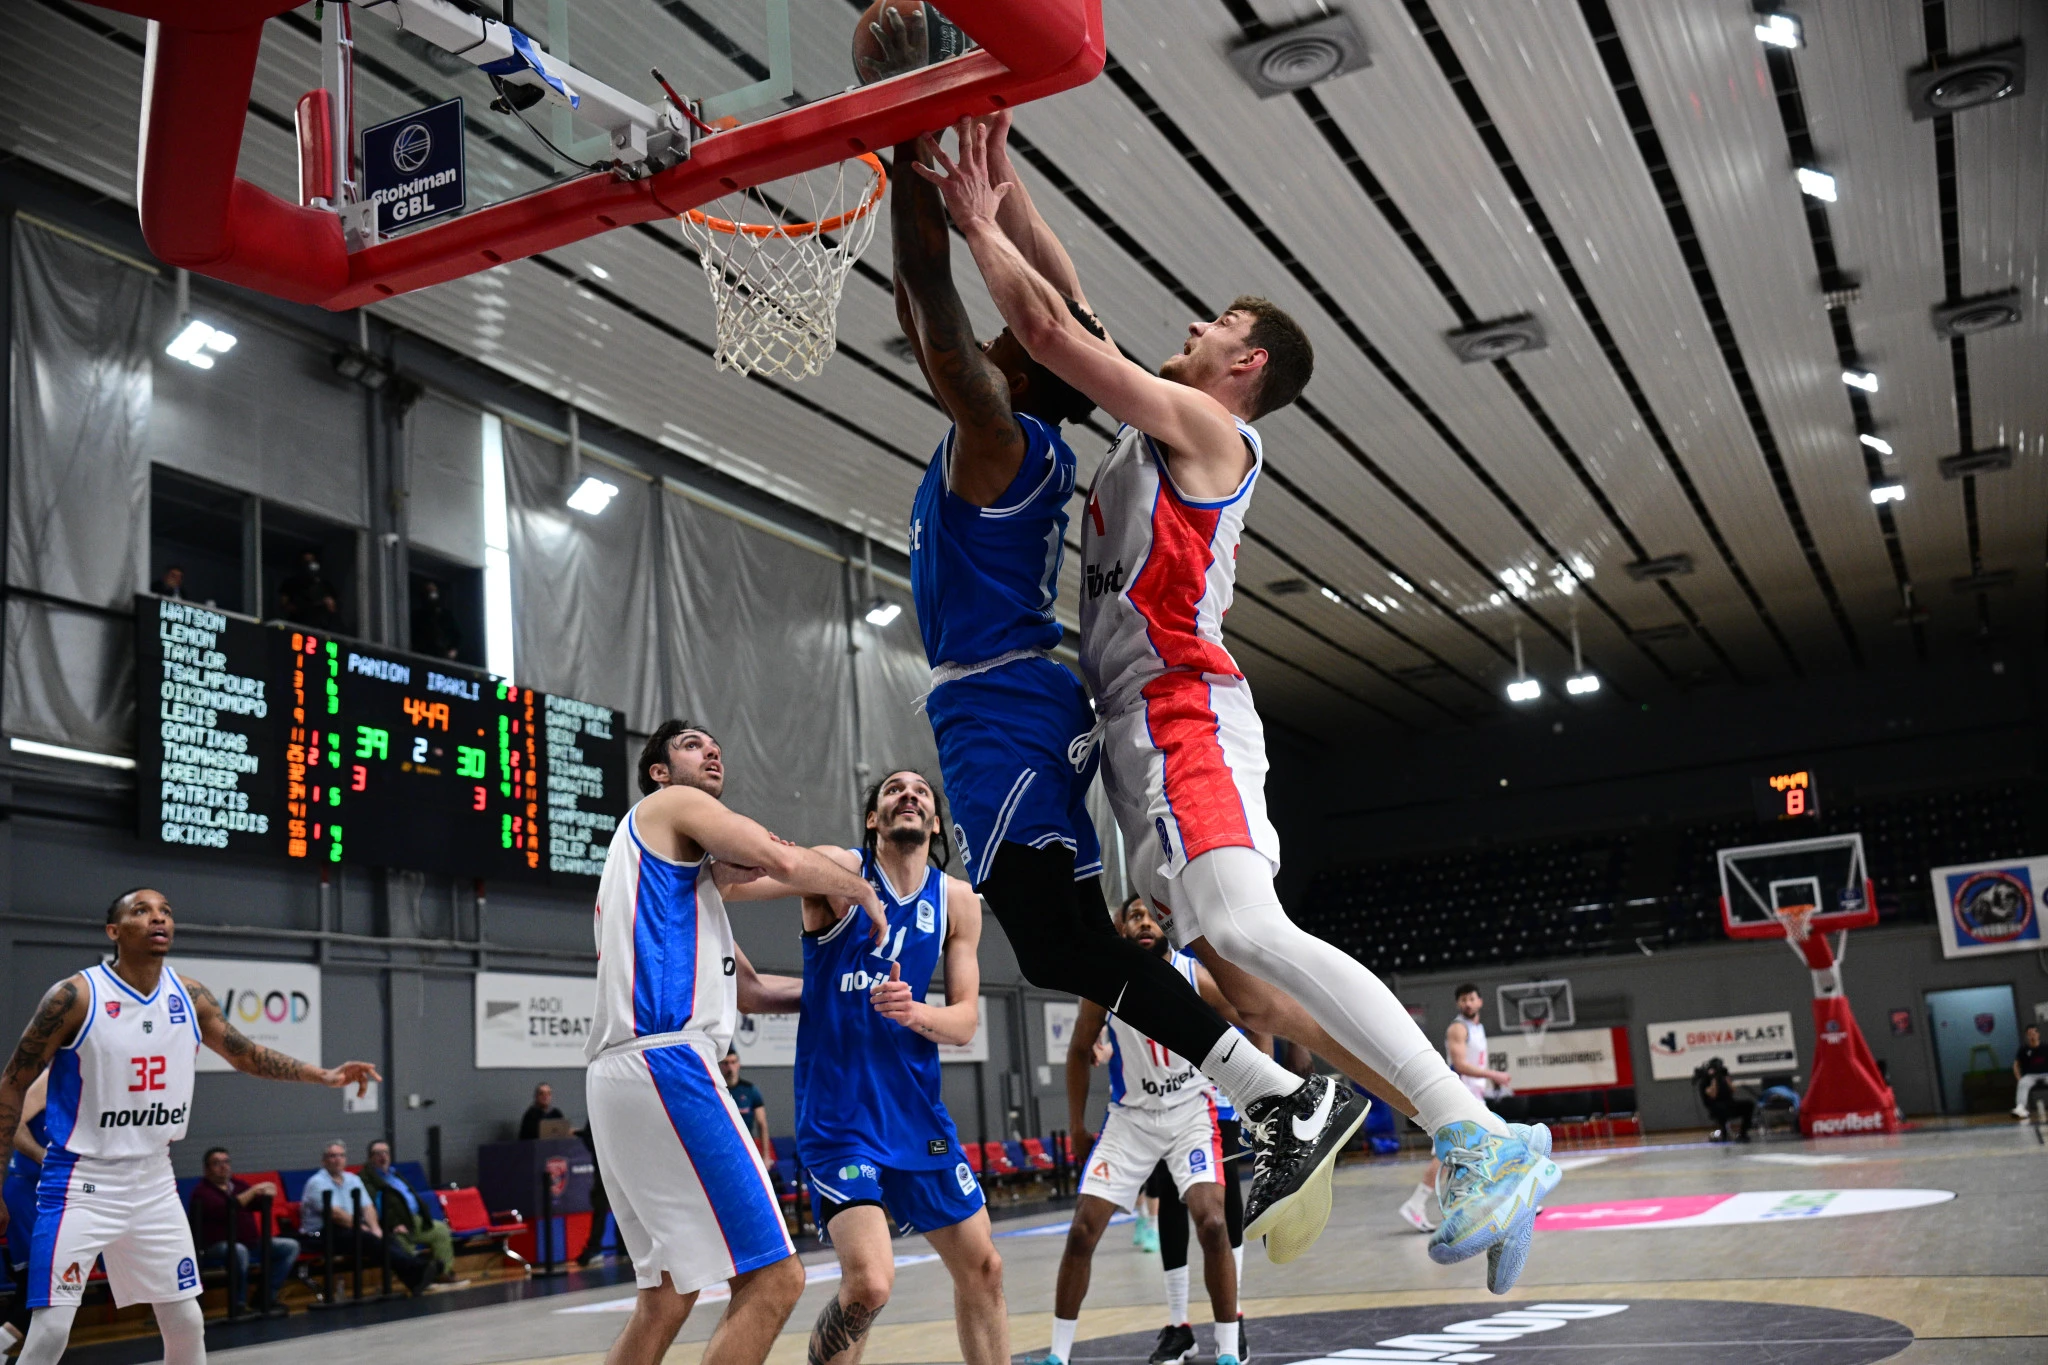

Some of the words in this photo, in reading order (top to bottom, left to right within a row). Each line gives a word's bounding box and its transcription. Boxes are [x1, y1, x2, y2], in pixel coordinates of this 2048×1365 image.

[371, 168, 457, 205] Stoiximan
[393, 193, 435, 221] GBL
[1086, 560, 1124, 600] ibet
[160, 600, 226, 633] WATSON
[160, 620, 216, 650] LEMON
[162, 640, 227, 671] TAYLOR
[162, 660, 265, 699] TSALMPOURI
[161, 680, 267, 719] OIKONOMOPO
[161, 700, 217, 728] LEWIS
[161, 721, 248, 753] GONTIKAS
[356, 725, 389, 760] 39
[413, 737, 428, 763] 2
[162, 741, 259, 774] THOMASSON
[456, 745, 486, 779] 30
[161, 761, 239, 790] KREUSER
[352, 765, 367, 791] 3
[162, 781, 249, 811] PATRIKIS
[473, 786, 487, 811] 3
[1787, 789, 1804, 815] 8
[162, 801, 269, 833] NIKOLAIDIS
[162, 822, 229, 848] GKIKAS
[529, 1016, 592, 1037] ΣΤΕΦΑΤ
[1686, 1024, 1785, 1045] DRIVAPLAST
[128, 1055, 166, 1092] 32
[100, 1102, 187, 1128] novibet
[1812, 1111, 1883, 1134] novibet
